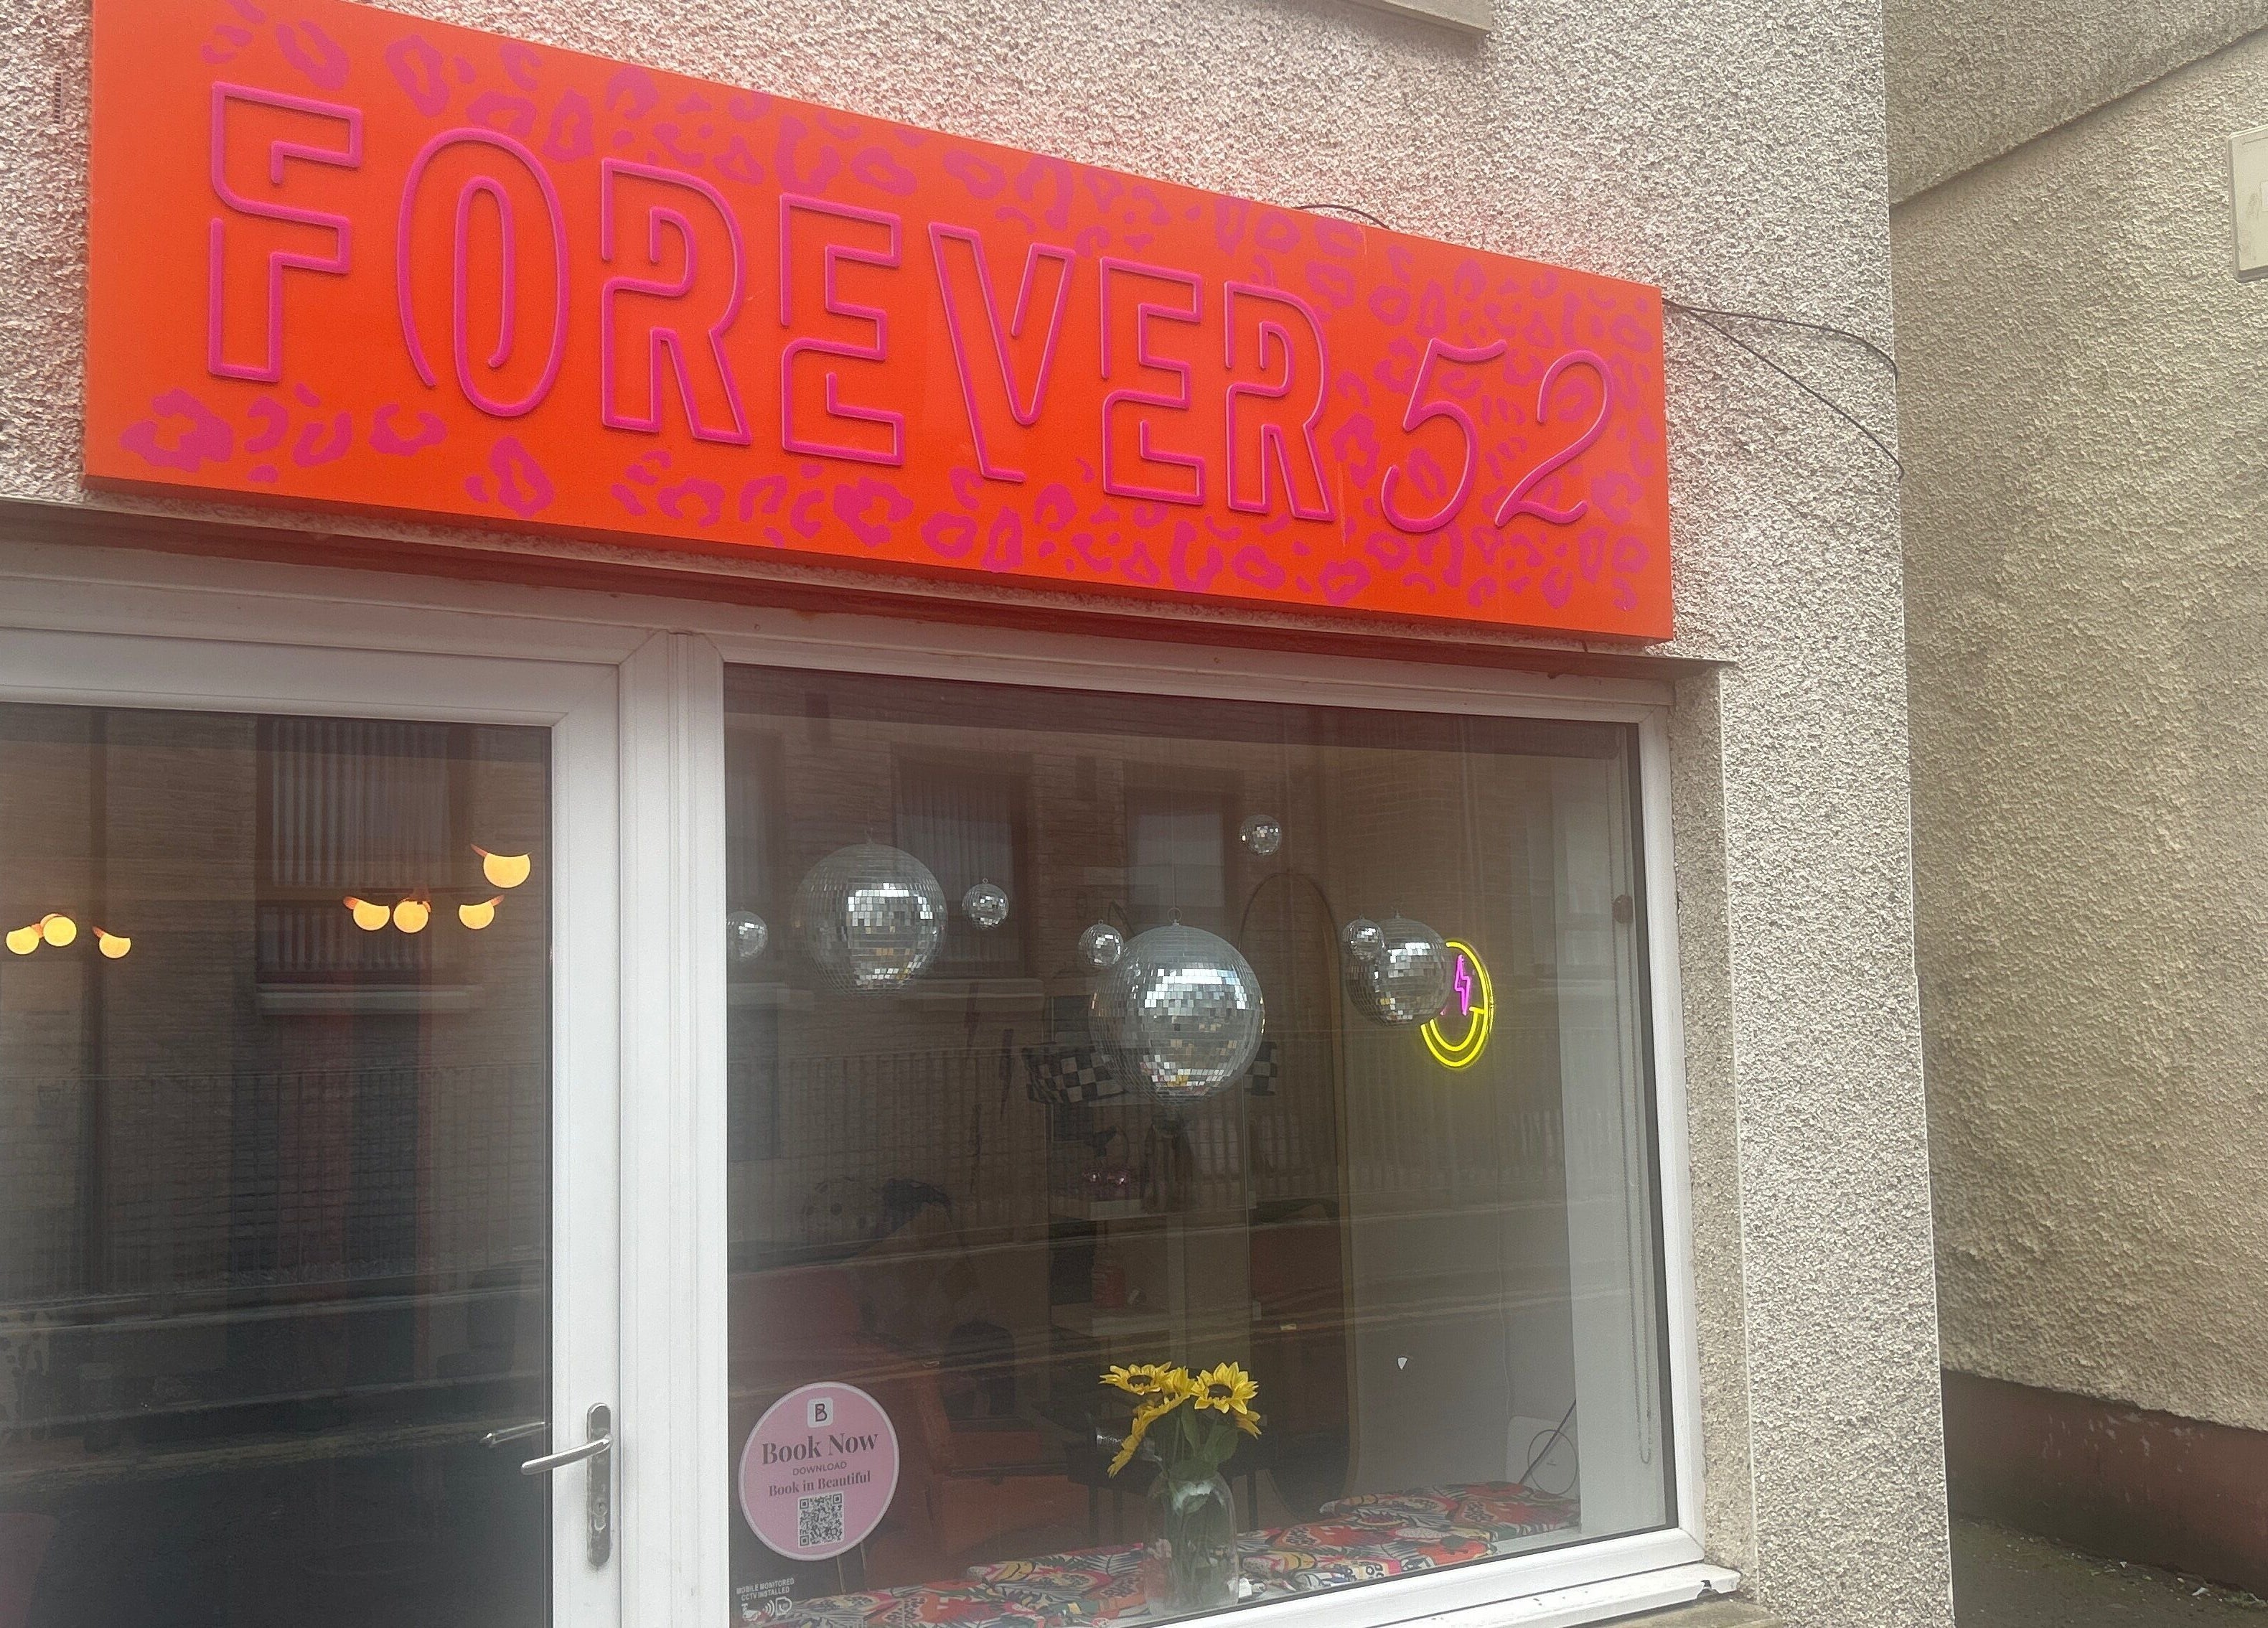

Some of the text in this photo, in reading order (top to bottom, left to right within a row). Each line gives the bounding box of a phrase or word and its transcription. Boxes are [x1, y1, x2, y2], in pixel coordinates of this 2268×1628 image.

[208, 80, 1616, 534] FOREVER 52
[762, 1433, 878, 1465] Book Now
[792, 1461, 848, 1476] DOWNLOAD
[769, 1470, 871, 1497] Book in Beautiful
[741, 1586, 790, 1601] CCTV INSTALLED
[759, 1577, 795, 1591] MONITORED
